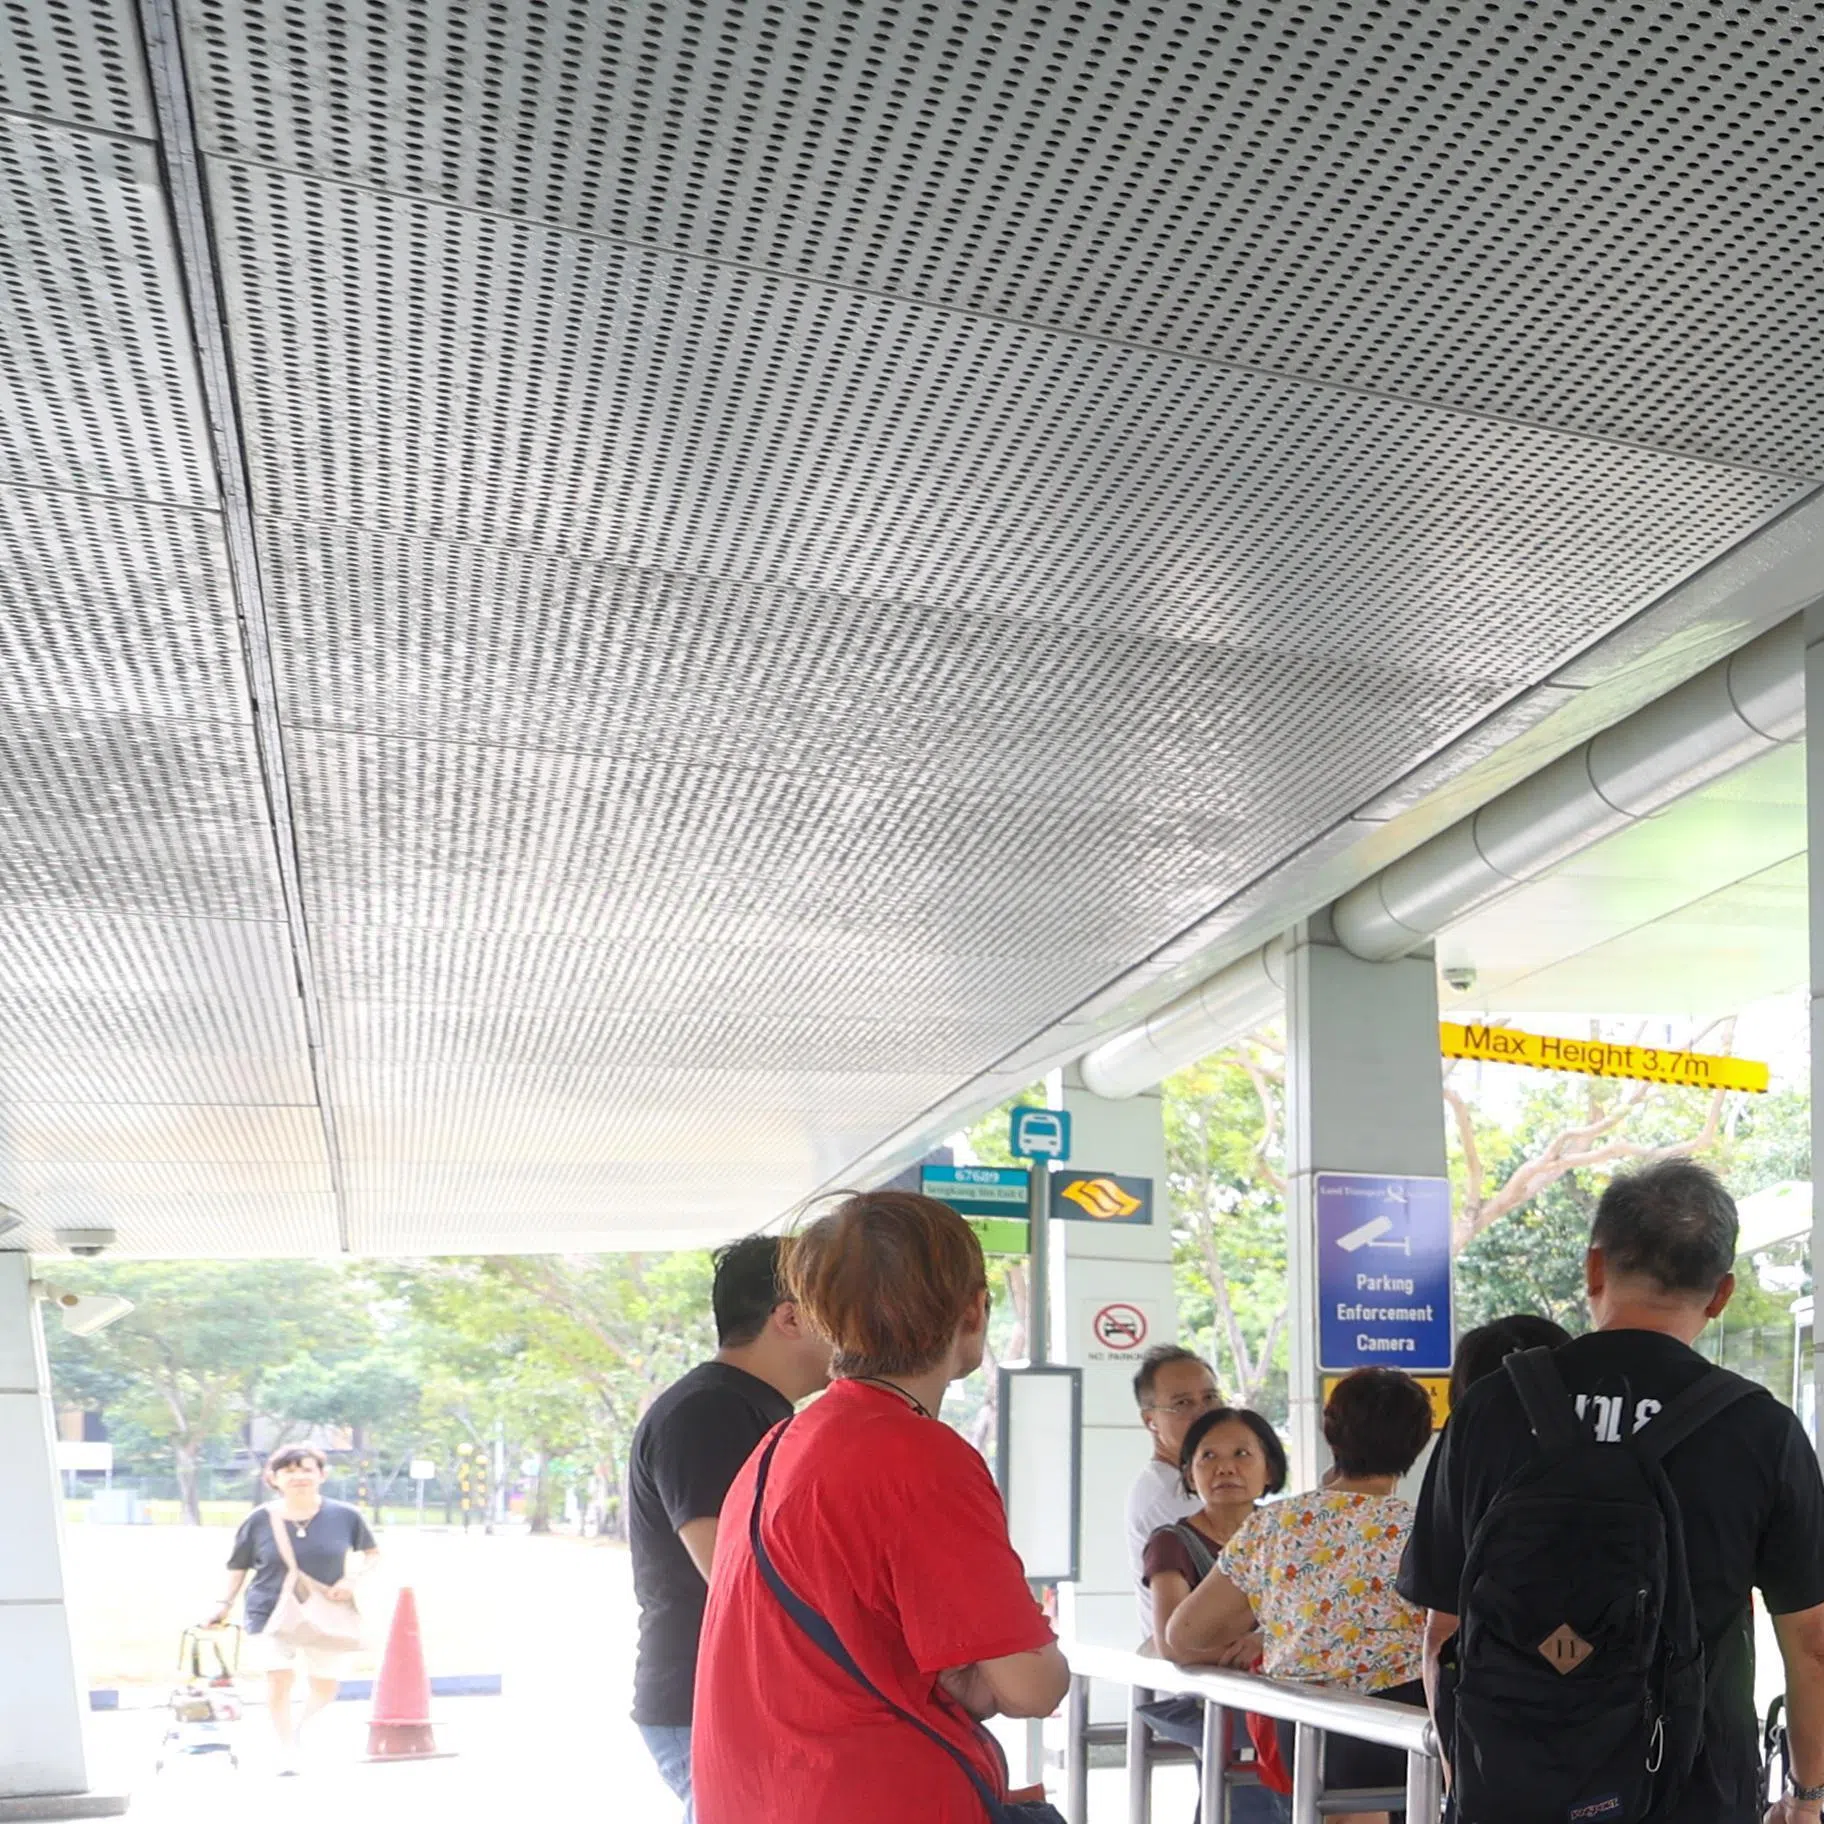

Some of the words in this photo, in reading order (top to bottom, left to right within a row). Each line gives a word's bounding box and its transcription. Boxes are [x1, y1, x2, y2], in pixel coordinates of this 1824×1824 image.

[1463, 1025, 1525, 1055] Max
[1540, 1038, 1632, 1071] Height
[1642, 1048, 1709, 1077] 3.7m
[1356, 1273, 1414, 1295] Parking
[1336, 1303, 1434, 1322] Enforcement
[1356, 1334, 1416, 1352] Camera
